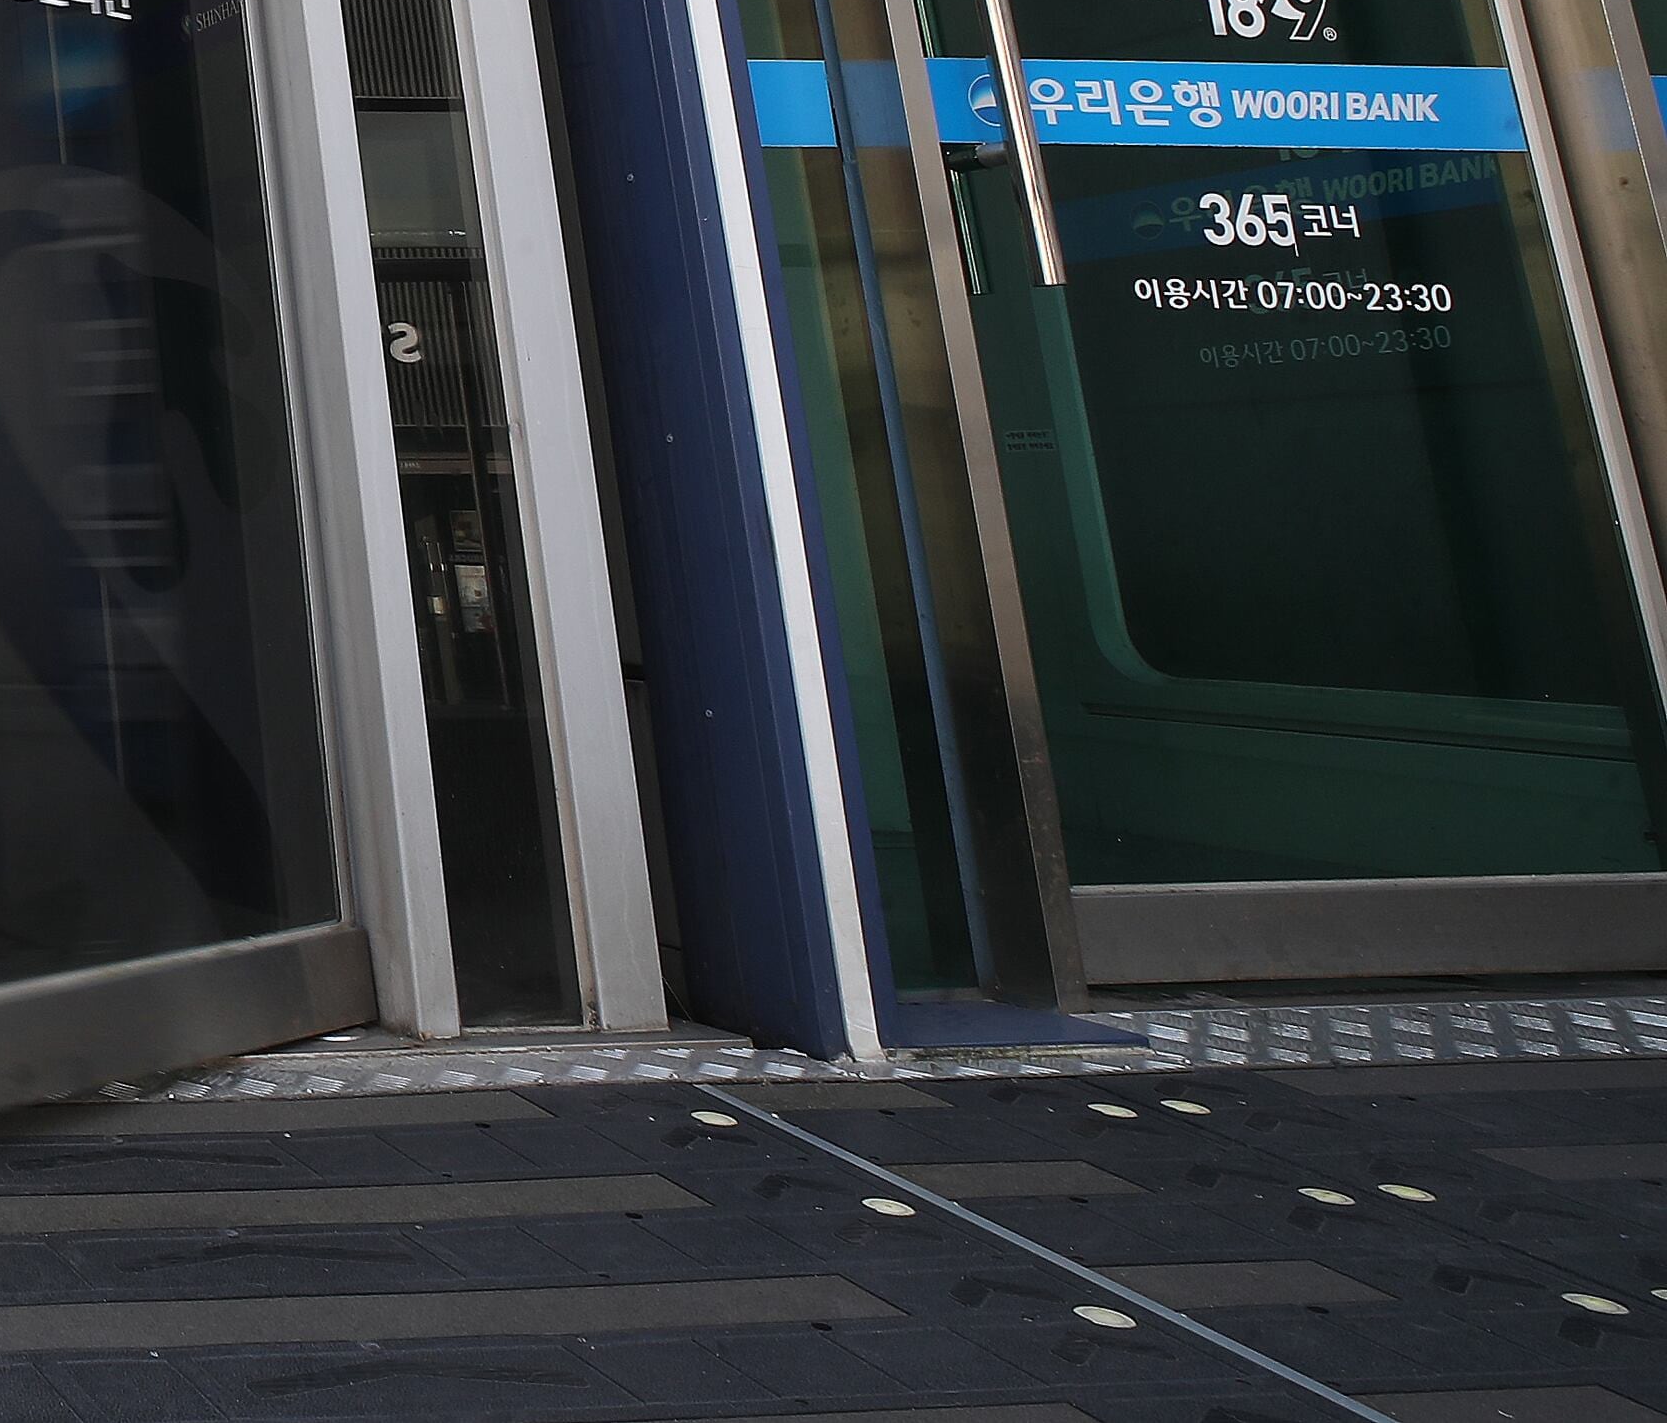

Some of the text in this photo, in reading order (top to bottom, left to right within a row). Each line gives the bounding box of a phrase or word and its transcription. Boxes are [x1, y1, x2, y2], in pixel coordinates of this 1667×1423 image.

[1028, 77, 1440, 129] 우리은행 WOORI BANK
[1198, 193, 1362, 247] 365 코너
[1133, 277, 1452, 313] 이용시간 07:00~23:30
[1199, 340, 1283, 369] 이용시간
